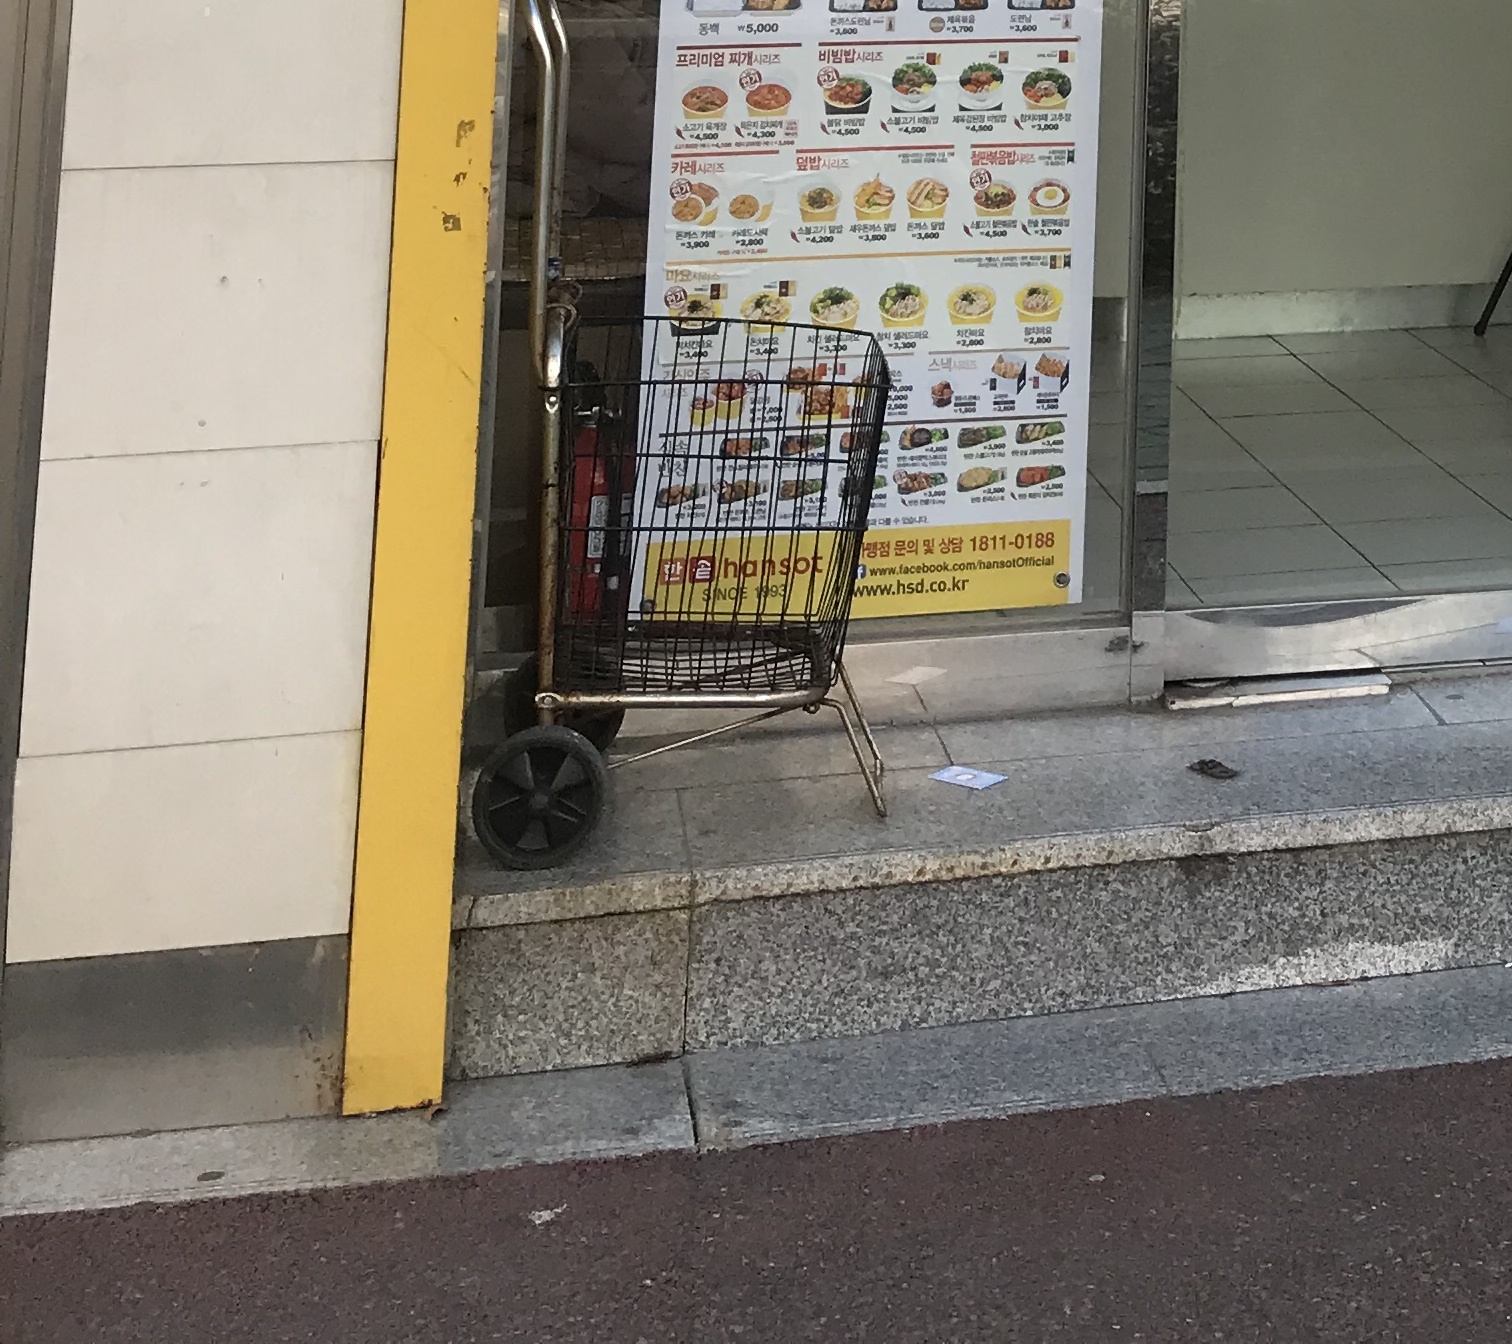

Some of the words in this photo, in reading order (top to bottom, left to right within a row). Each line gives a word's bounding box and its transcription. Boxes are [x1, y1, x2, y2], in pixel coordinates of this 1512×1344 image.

[676, 53, 725, 67] 프리미엄
[819, 49, 883, 64] 비빔밥시리즈
[671, 161, 725, 174] 카레시리즈
[796, 156, 850, 171] 덮밥시리즈
[894, 540, 918, 556] 문의
[923, 539, 934, 555] 및
[939, 537, 963, 554] 상담
[970, 532, 1054, 551] 1811-0188
[724, 551, 823, 578] hansot
[870, 556, 1054, 576] www.facebook.com/hansotOfficial
[854, 577, 969, 597] www.hsd.co.kr
